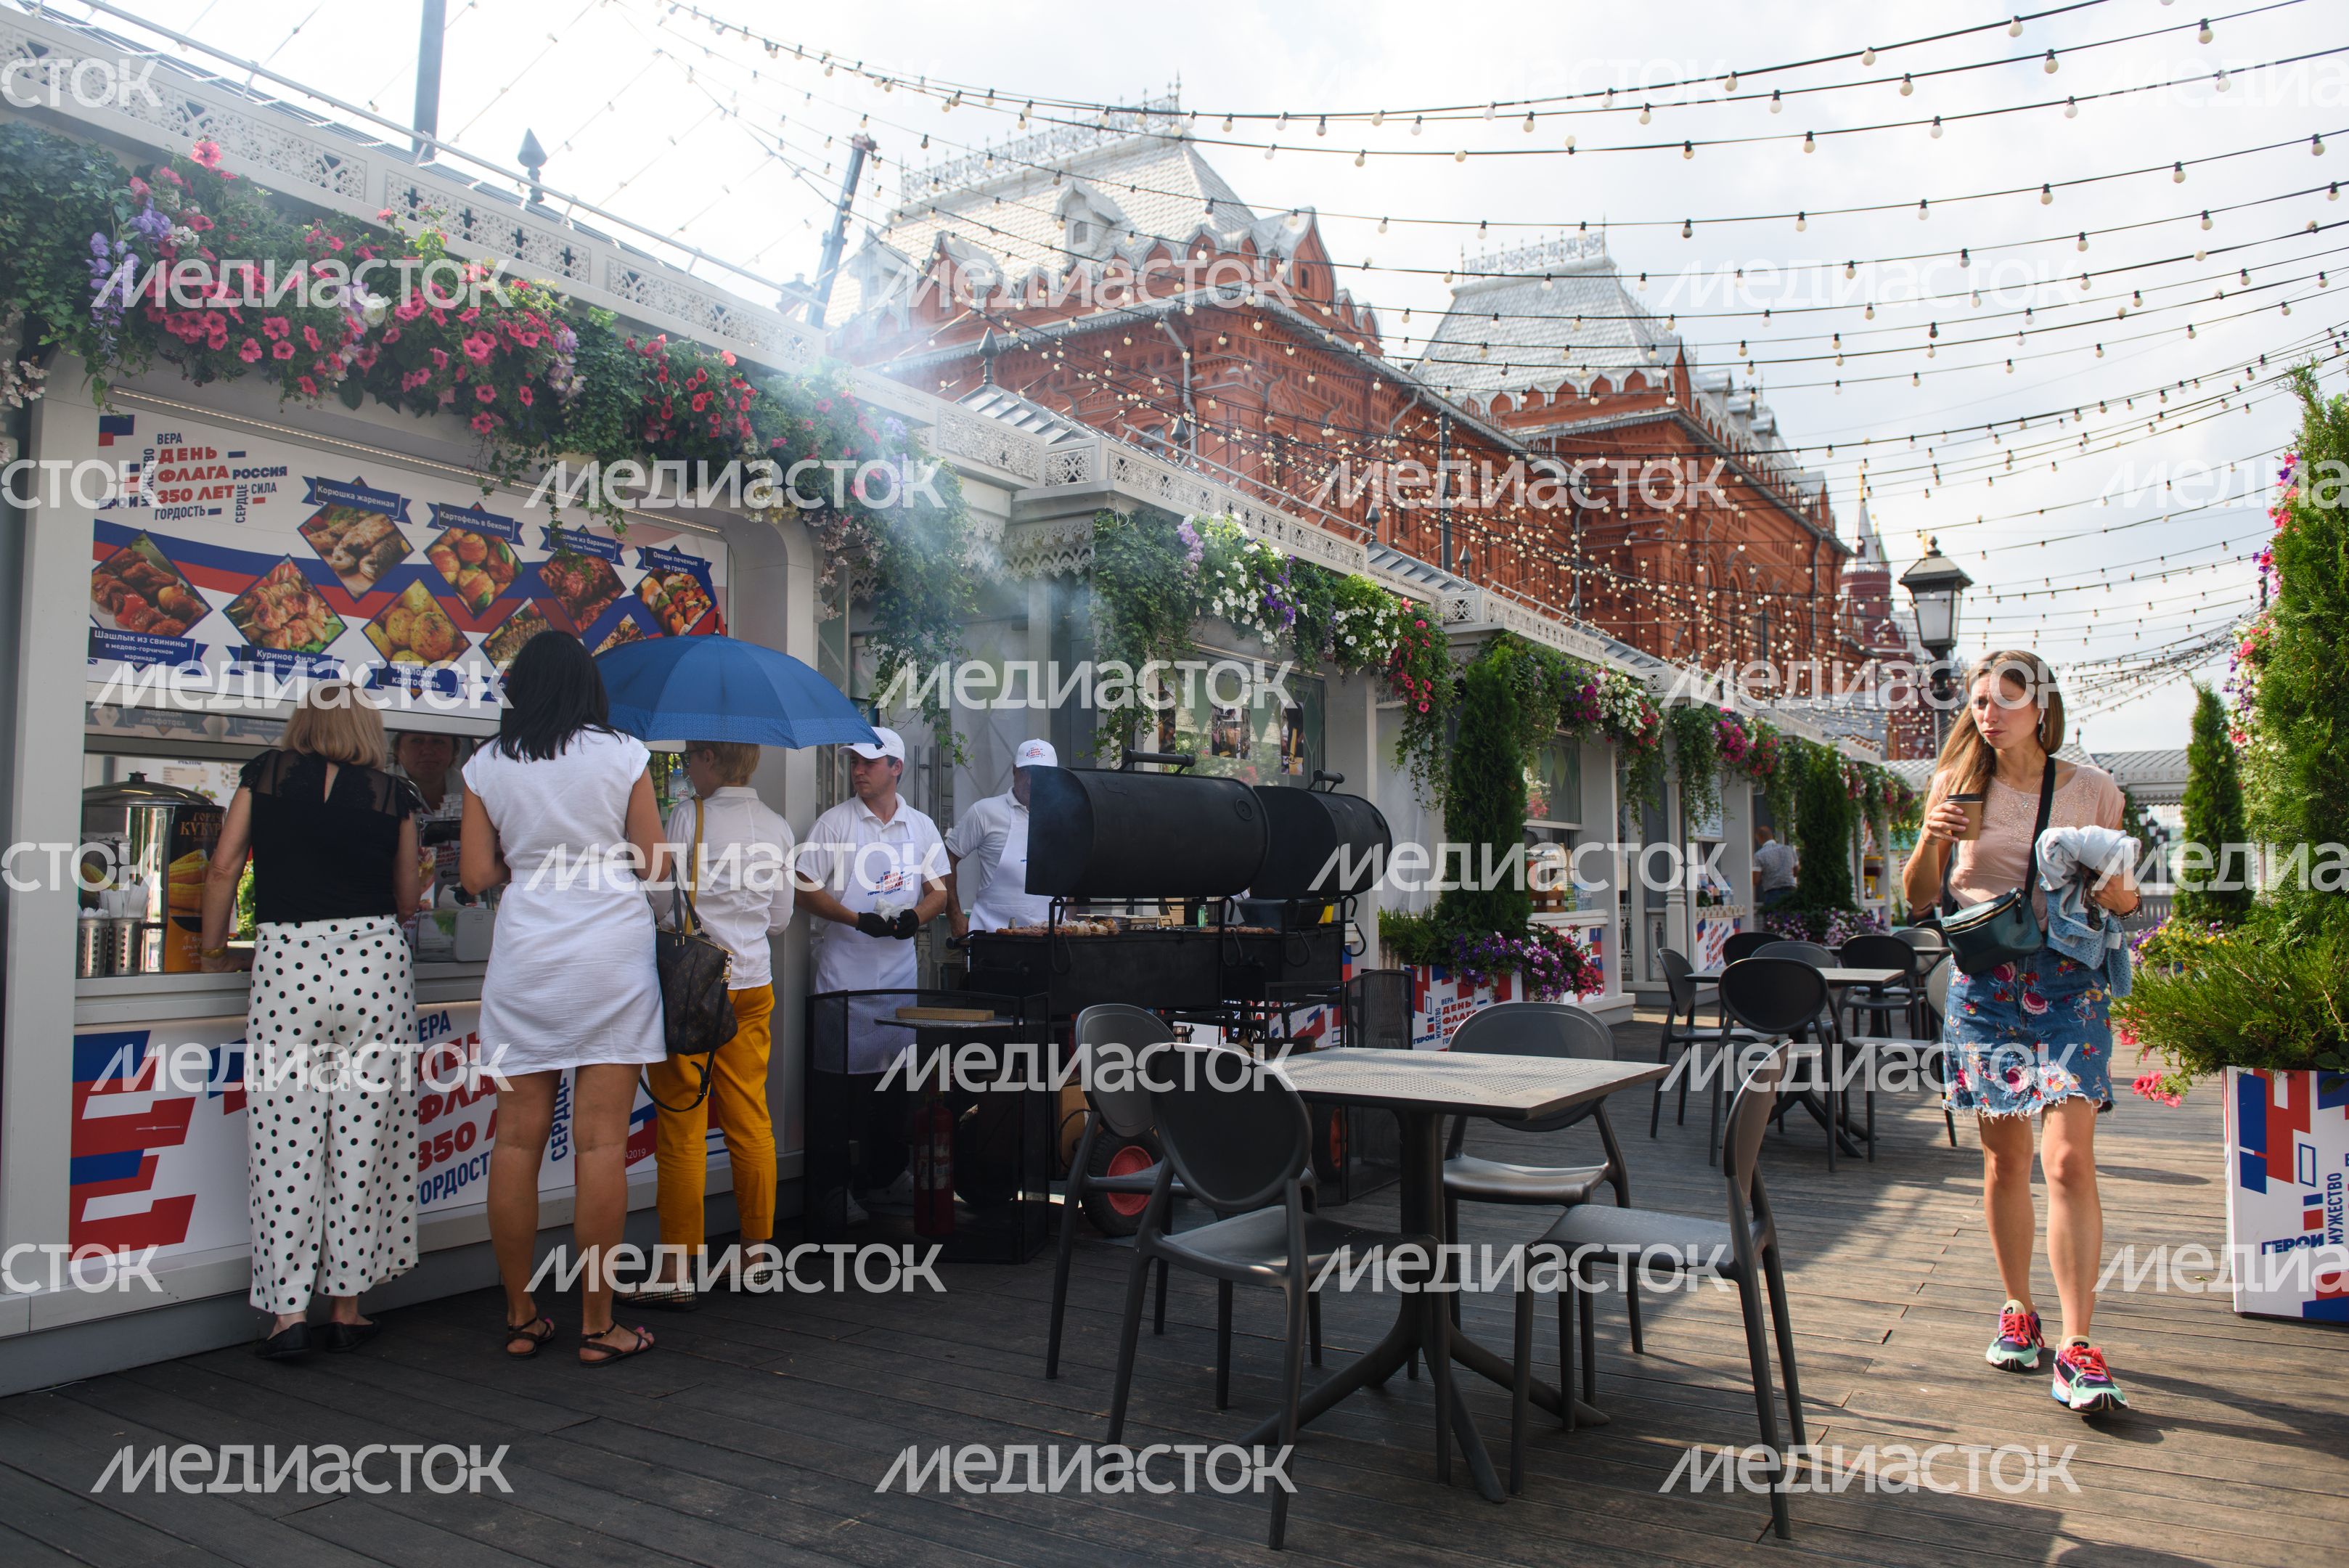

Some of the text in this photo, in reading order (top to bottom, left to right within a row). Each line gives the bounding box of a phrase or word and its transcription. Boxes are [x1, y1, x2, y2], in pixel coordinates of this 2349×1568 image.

[158, 433, 182, 444] ВЕРА
[158, 446, 217, 464] ДЕНЬ
[158, 465, 229, 483] ФЛАГА
[233, 466, 287, 479] РОССИЯ
[158, 485, 234, 504] 350 ЛЕТ
[251, 482, 277, 494] СИЛА
[235, 484, 250, 523] СЕРДЦЕ
[317, 485, 395, 508] Корюшка жаренная
[155, 505, 205, 520] ГОРДОСТЬ
[440, 510, 480, 526] Картофель
[486, 520, 511, 532] беконе
[587, 537, 615, 549] баранины
[653, 551, 698, 566] Овощи печеные
[94, 629, 136, 642] Шашлык
[149, 638, 188, 648] свинины
[111, 643, 174, 655] медово-горчичном
[256, 649, 317, 663] Куриное филе
[397, 664, 438, 678] Молодой
[391, 676, 441, 689] картофель
[1441, 997, 1454, 1005] ВЕРА
[1442, 1000, 1472, 1015] ДЕНЬ
[417, 1010, 452, 1042] ЕРА
[1413, 1034, 1435, 1045] ГЕРОИ
[418, 1073, 497, 1126] ФЛА
[418, 1121, 476, 1172] 350
[417, 1151, 491, 1205] ОРДОСТ
[2326, 1172, 2343, 1245] МУЖЕСТВО
[2261, 1233, 2324, 1255] ГЕРОИ
